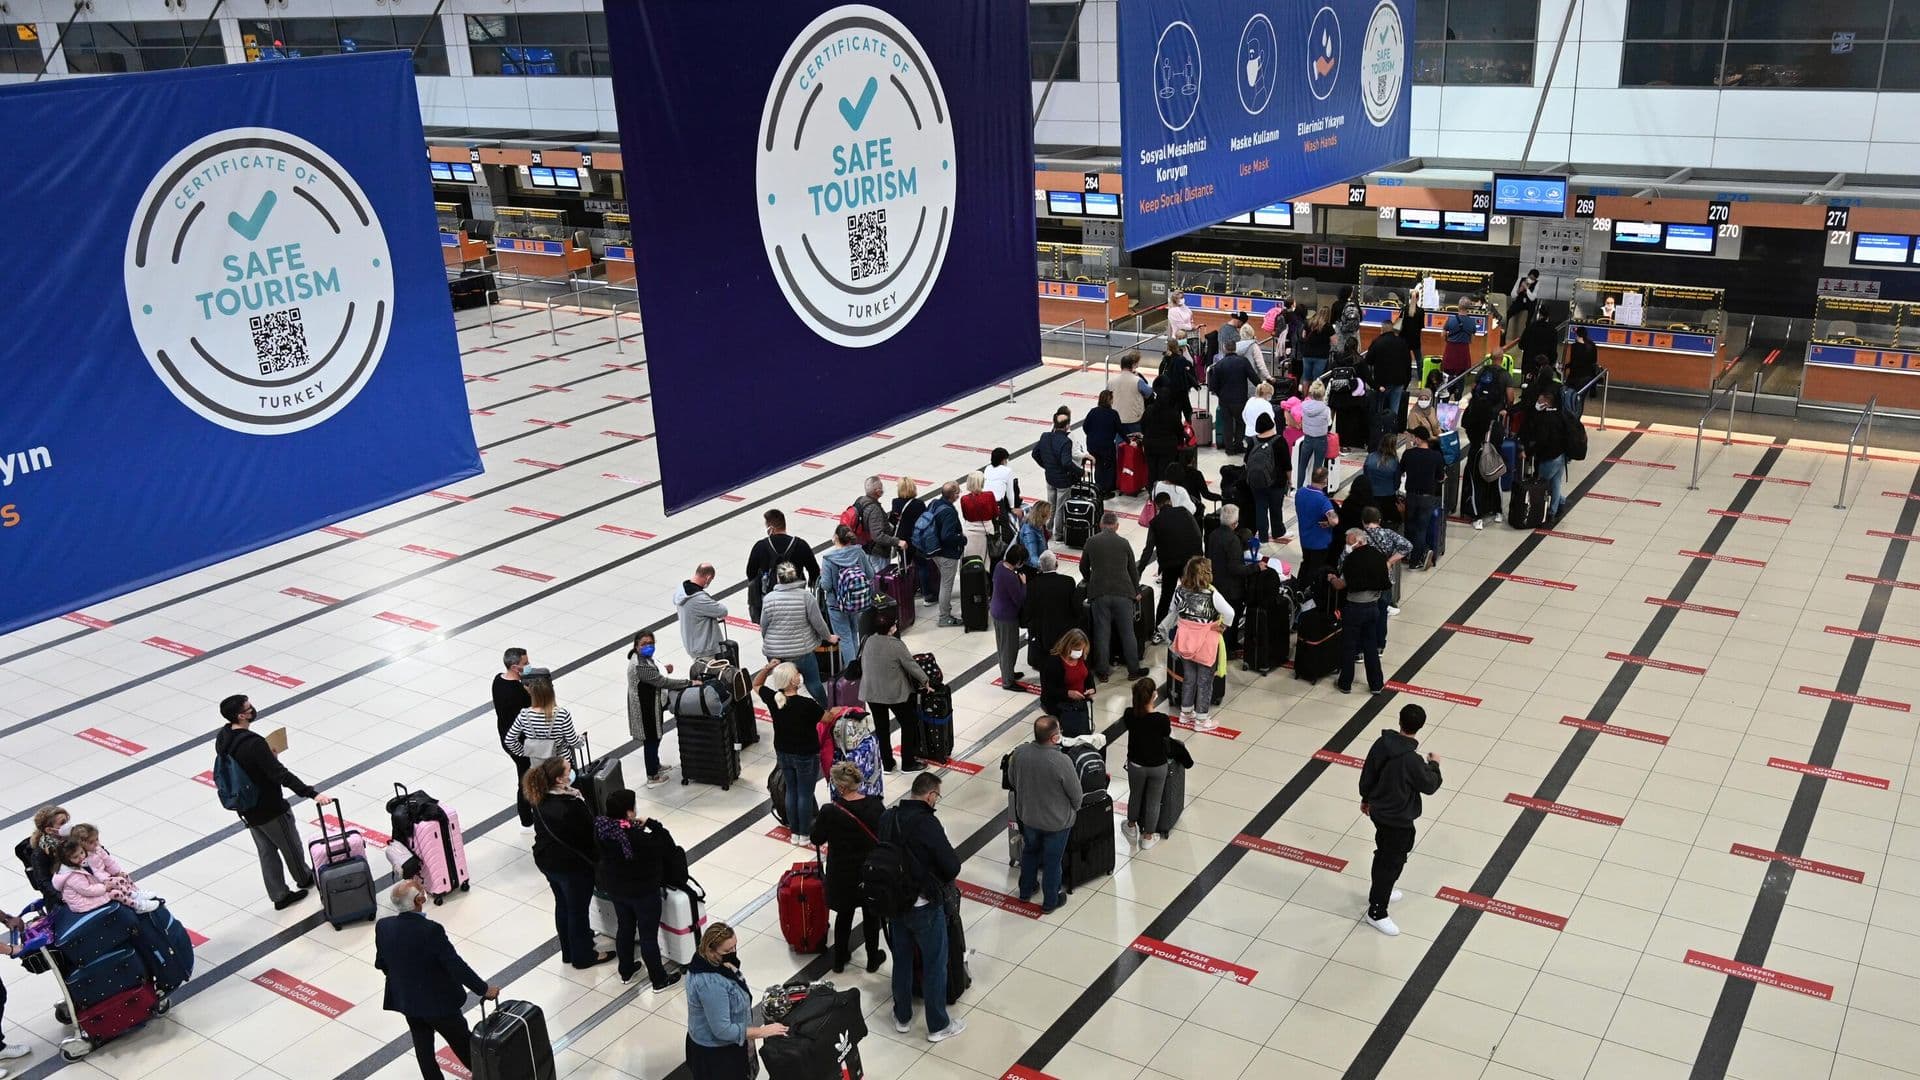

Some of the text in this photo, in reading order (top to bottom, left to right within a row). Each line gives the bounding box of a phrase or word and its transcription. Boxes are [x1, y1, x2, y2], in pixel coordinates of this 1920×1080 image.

[1377, 48, 1391, 60] SAFE
[799, 36, 909, 91] CERTIFICATE OF
[1371, 61, 1395, 76] TOURISM
[1297, 119, 1324, 136] Ellerinizi
[1230, 134, 1252, 152] Maske
[1320, 134, 1338, 148] Hands
[832, 137, 894, 176] SAFE
[1140, 136, 1207, 165] Sosyal Mesafenizi
[1156, 164, 1188, 183] Koruyun
[1240, 156, 1269, 176] Use Mask
[174, 155, 318, 210] CERTIFICATE OF
[1085, 176, 1098, 189] 264
[808, 167, 918, 216] TOURISM
[1140, 184, 1214, 215] Keep Social Distance
[1350, 189, 1365, 202] 267
[1294, 201, 1310, 214] 266
[1473, 194, 1490, 208] 268
[1576, 200, 1595, 214] 269
[1380, 206, 1396, 219] 267
[1709, 205, 1728, 220] 270
[1827, 211, 1847, 226] 271
[1593, 217, 1611, 231] 269
[1718, 224, 1739, 238] 270
[1830, 231, 1851, 245] 271
[223, 243, 306, 283] SAFE
[195, 267, 341, 321] TOURISM
[848, 291, 897, 318] TURKEY
[259, 381, 325, 408] TURKEY
[1440, 893, 1560, 928] KEEP YOUR SOCIAL DISTANCE
[1487, 900, 1517, 911] PLEASE
[1133, 943, 1153, 953] KEEP
[1154, 949, 1177, 960] YOUR
[1177, 957, 1207, 970] SOCIAL
[1180, 950, 1210, 962] PLEASE
[1688, 958, 1722, 971] SOSYAL
[1780, 982, 1827, 998] KORUYUN
